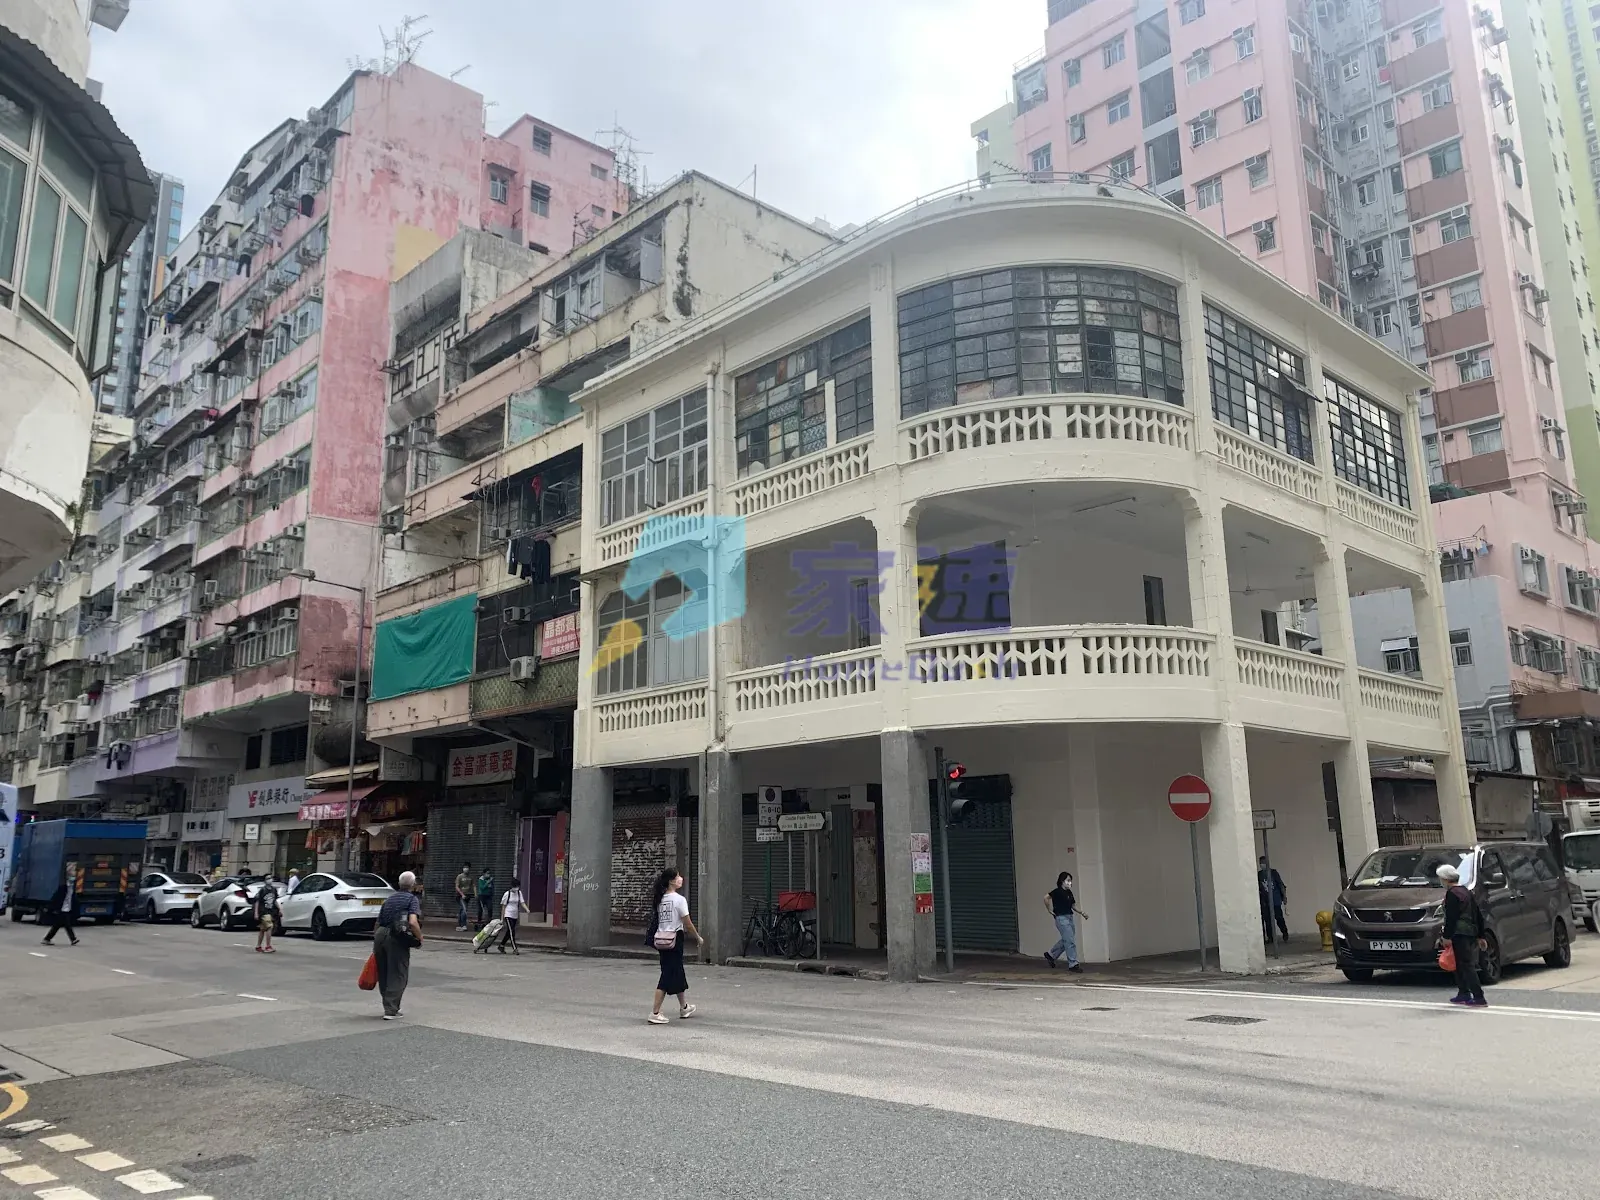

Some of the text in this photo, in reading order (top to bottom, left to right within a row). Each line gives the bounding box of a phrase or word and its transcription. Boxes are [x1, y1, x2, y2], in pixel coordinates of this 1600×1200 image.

[452, 749, 513, 778] 金富源電器
[1373, 941, 1383, 949] PY
